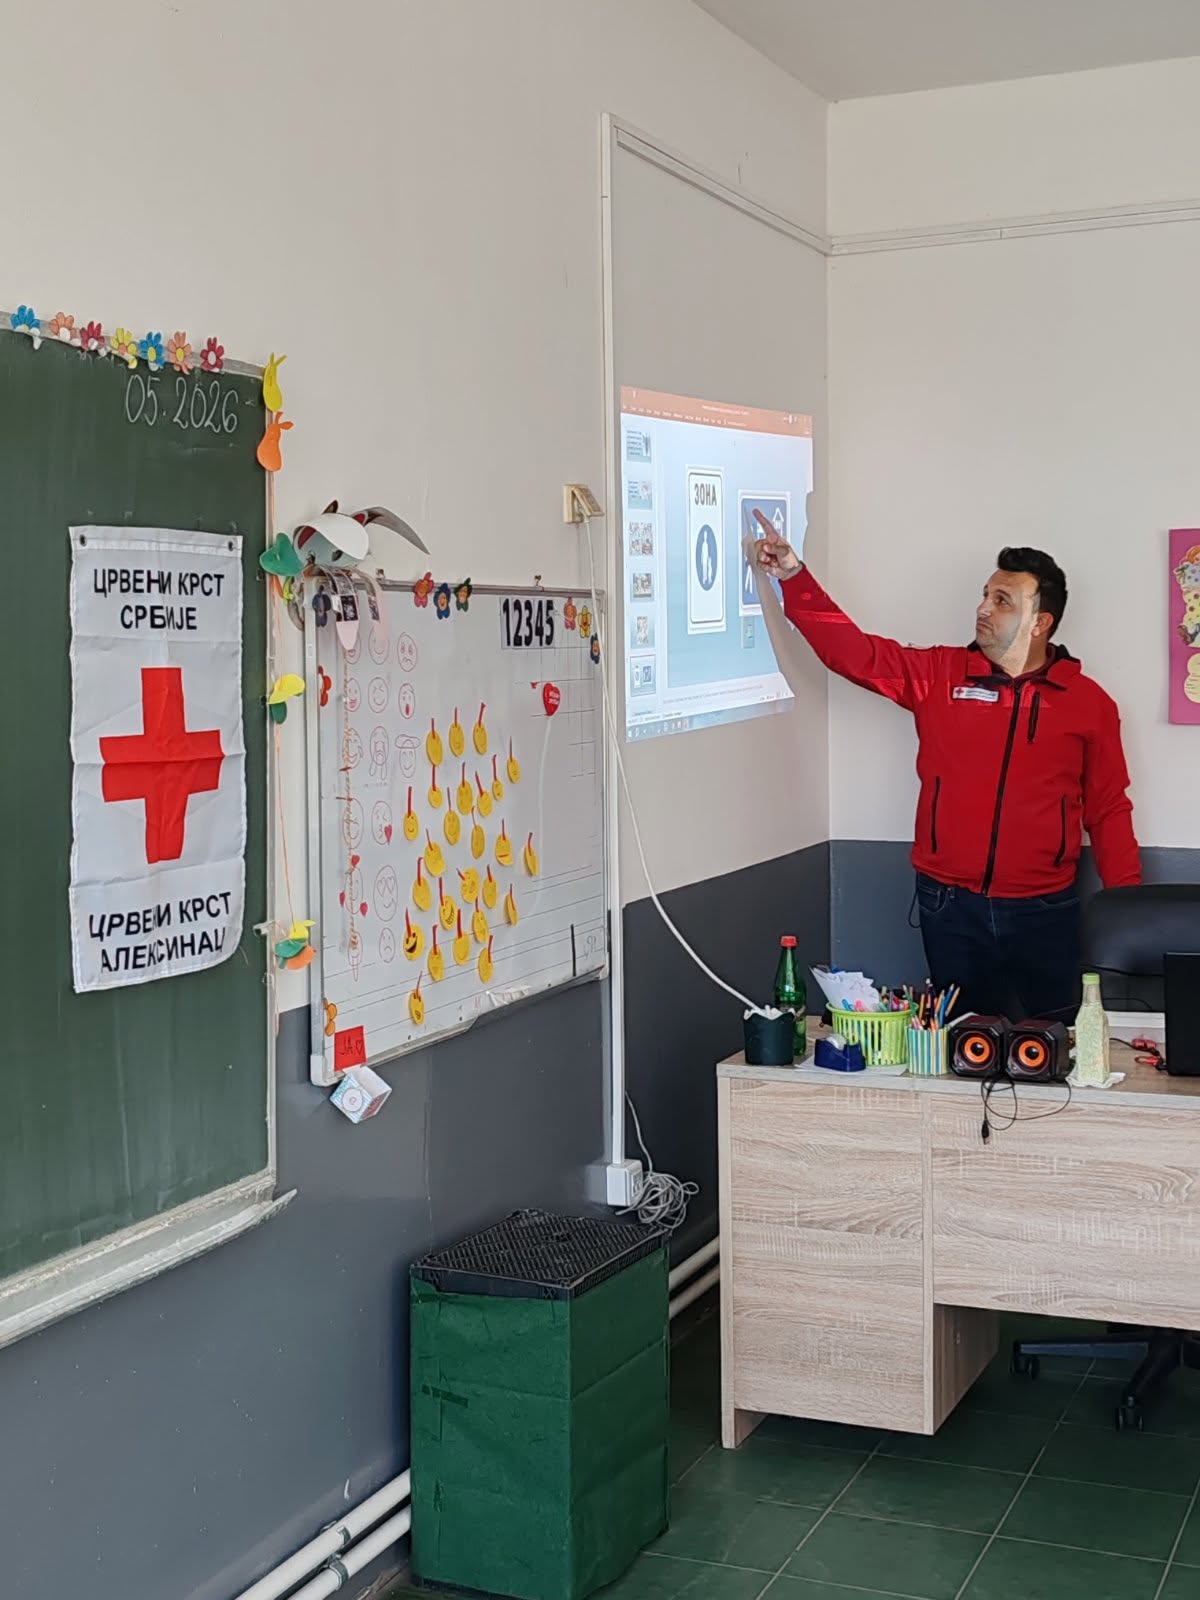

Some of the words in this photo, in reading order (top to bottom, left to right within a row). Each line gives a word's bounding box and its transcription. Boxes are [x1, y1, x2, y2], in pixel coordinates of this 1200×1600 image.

[694, 483, 717, 506] ЗОНА
[94, 568, 172, 598] ЦРВЕНИ
[178, 572, 225, 597] КРСТ
[120, 604, 197, 630] СРБИЈЕ
[179, 892, 231, 924] КРСТ
[101, 927, 225, 973] АЛЕКСИНАЦ
